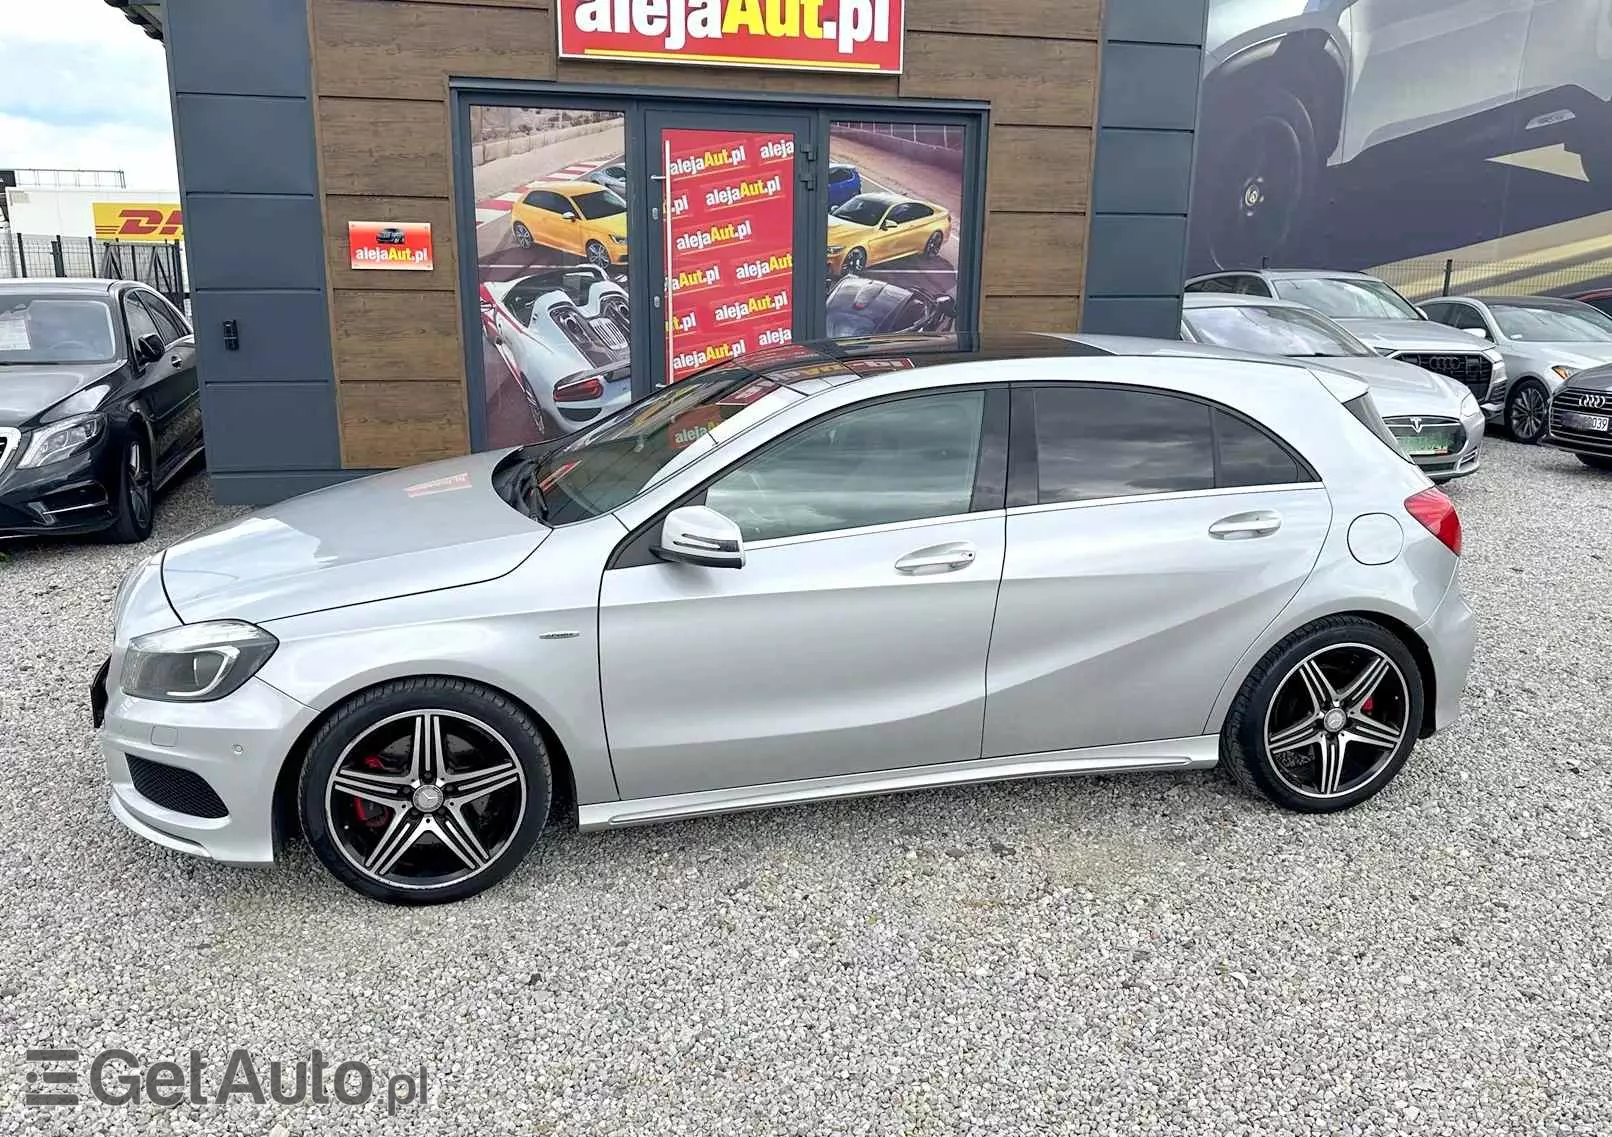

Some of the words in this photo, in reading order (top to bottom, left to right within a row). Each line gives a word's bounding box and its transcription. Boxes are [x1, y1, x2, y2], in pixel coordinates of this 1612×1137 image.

[669, 145, 747, 176] alejaAut.pl
[759, 139, 795, 159] aleja
[705, 175, 781, 206] alejaAut.pl
[676, 220, 752, 250] alejaAut.pl
[355, 246, 428, 263] alejaAut.pl
[735, 254, 793, 279] alejaAut
[714, 291, 788, 321] alejaAut.pl
[759, 328, 792, 345] aleja
[673, 339, 746, 369] alejaAut.pl
